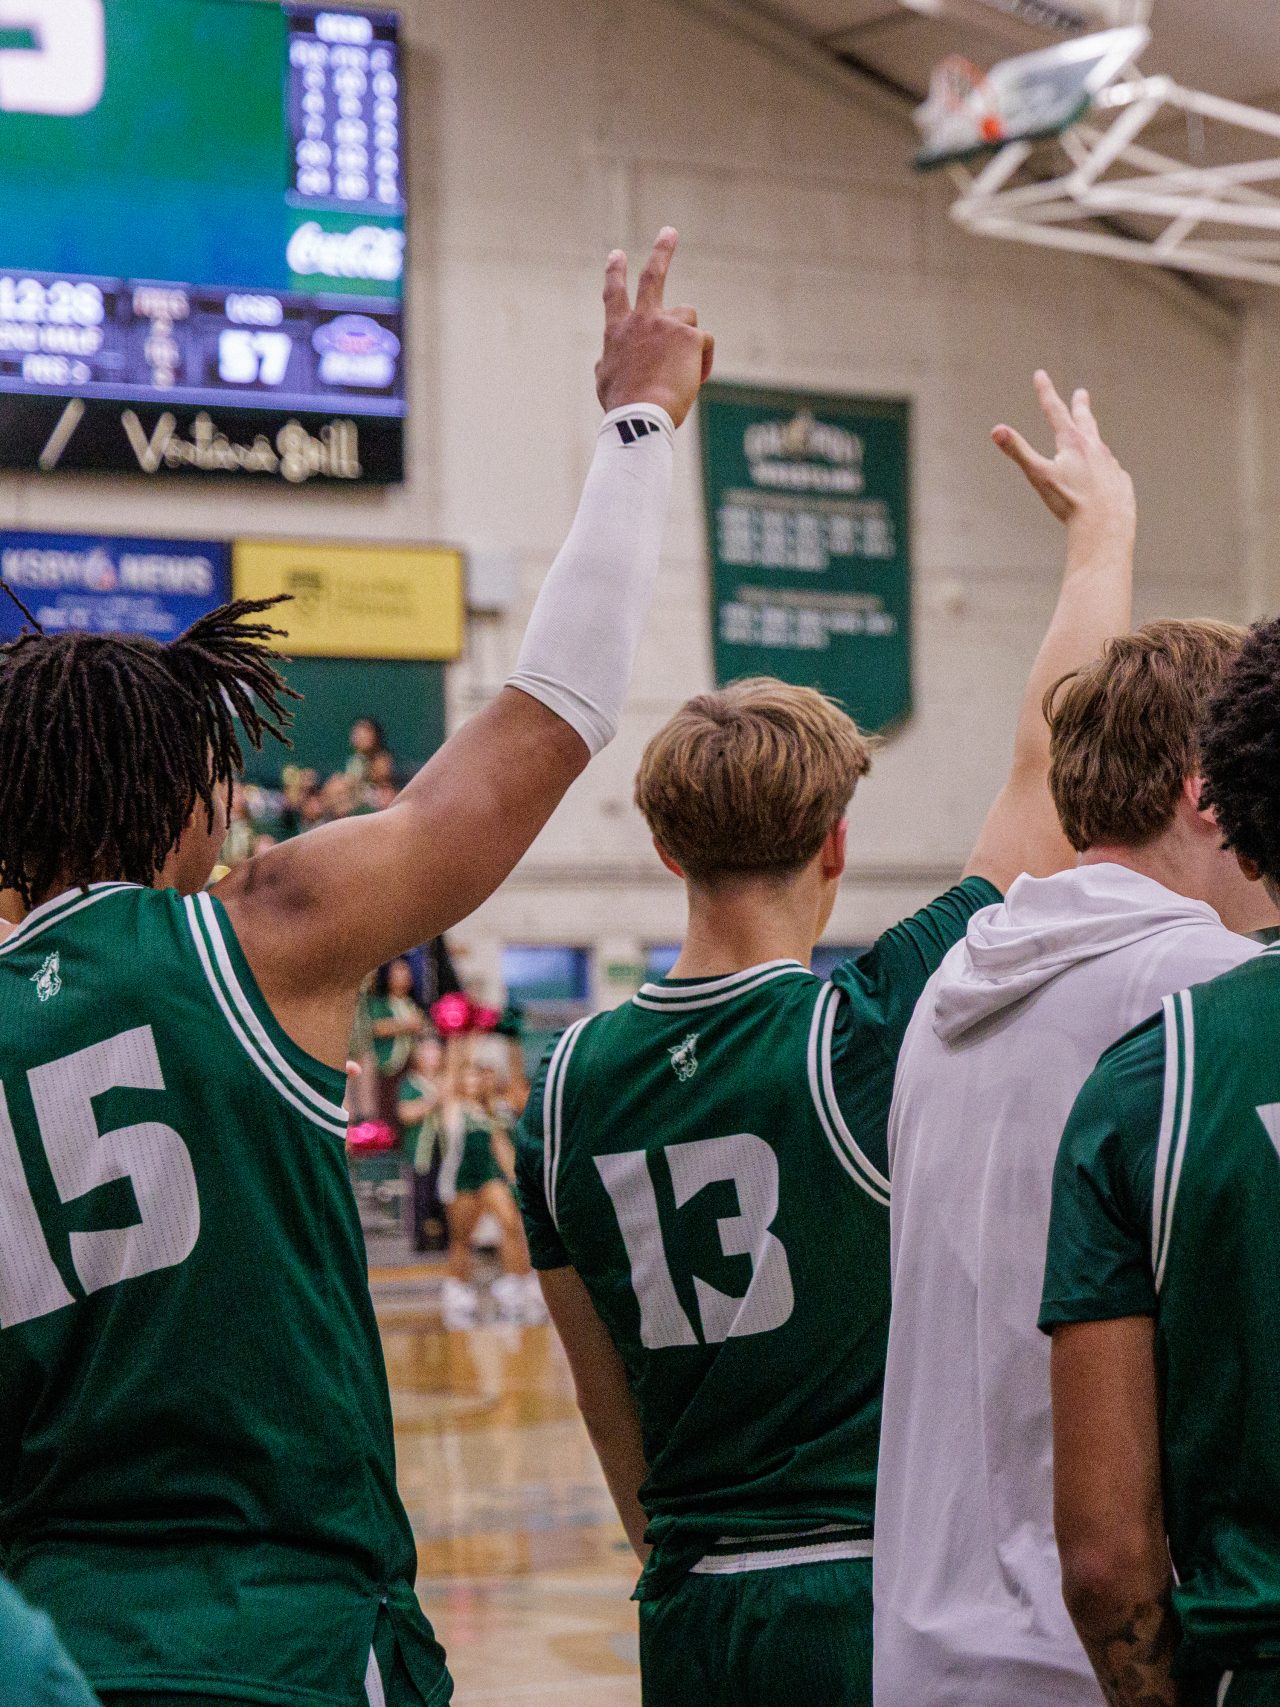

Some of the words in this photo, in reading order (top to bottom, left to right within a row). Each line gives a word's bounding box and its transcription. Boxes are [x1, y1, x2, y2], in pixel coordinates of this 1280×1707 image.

[120, 553, 214, 596] NEWS
[0, 1024, 200, 1329] 15
[593, 1133, 795, 1350] 13
